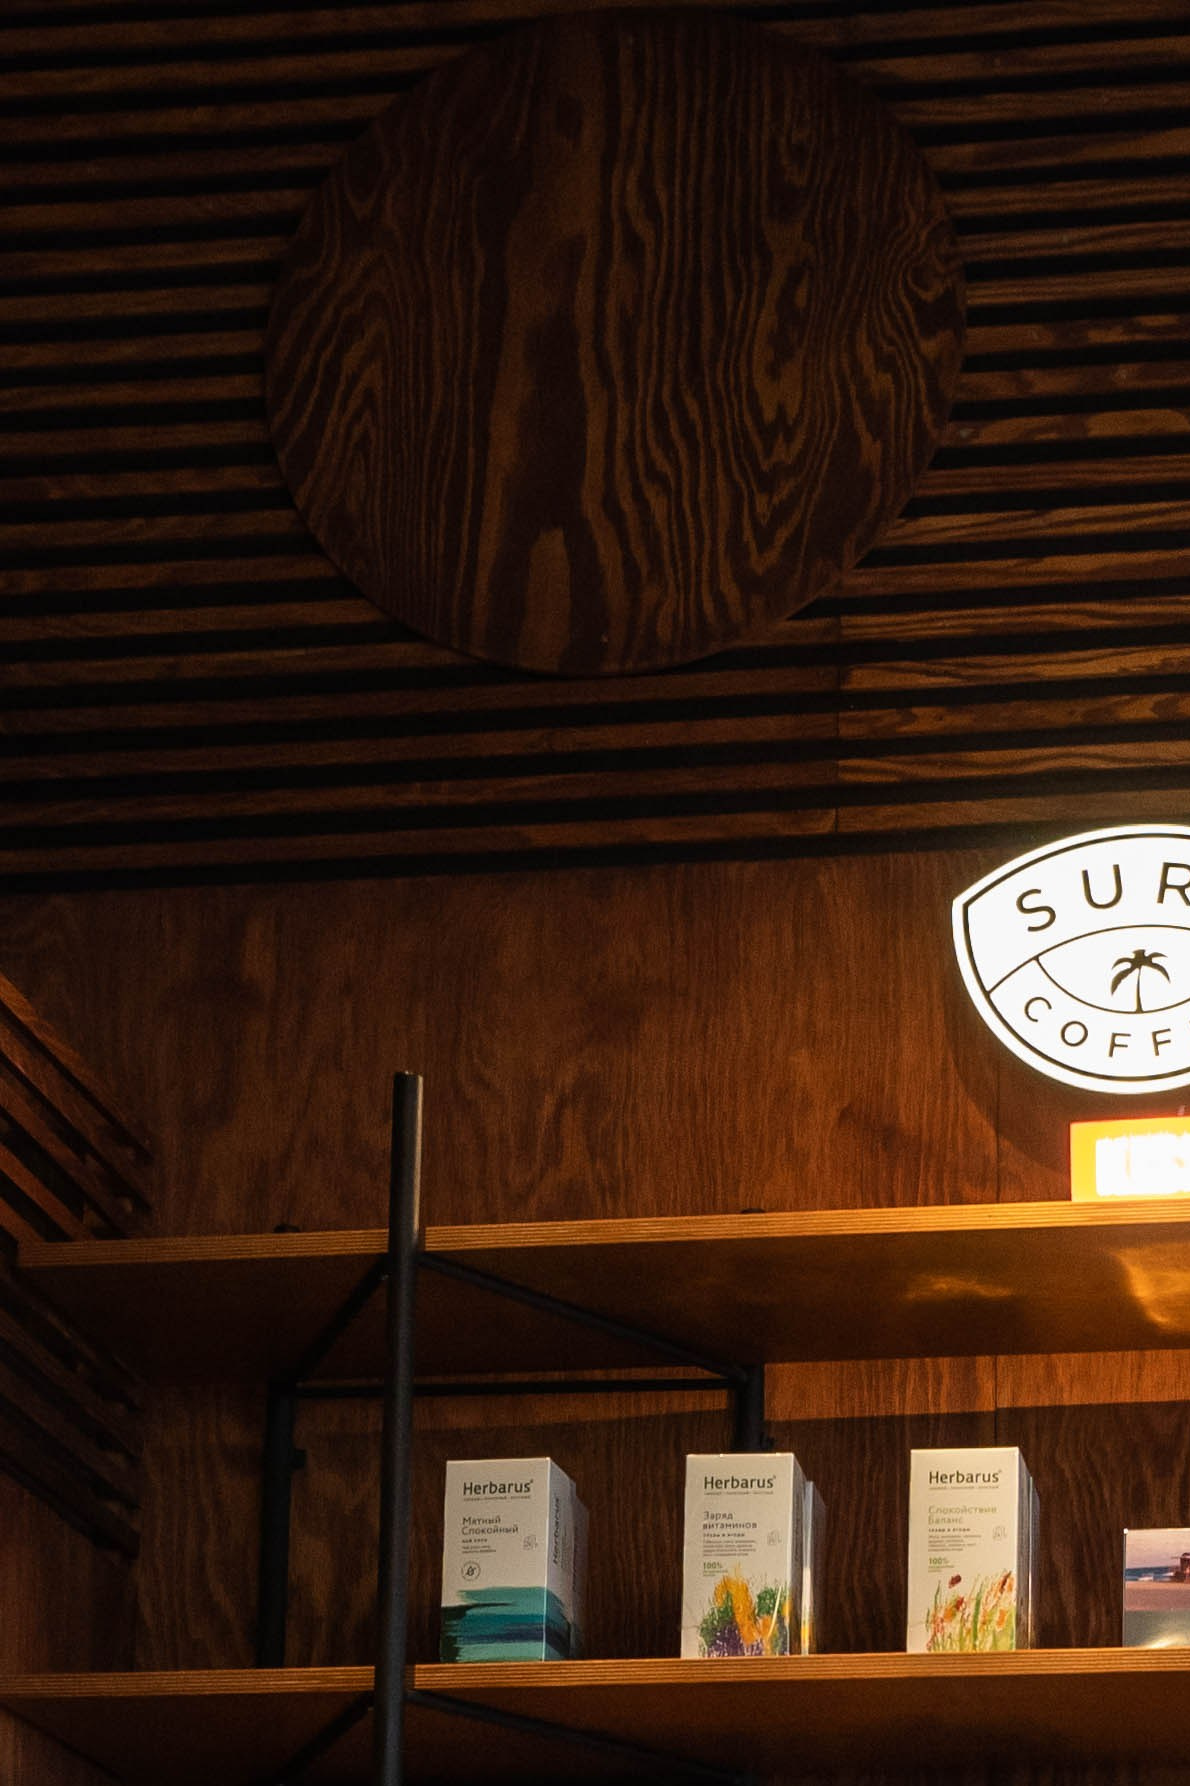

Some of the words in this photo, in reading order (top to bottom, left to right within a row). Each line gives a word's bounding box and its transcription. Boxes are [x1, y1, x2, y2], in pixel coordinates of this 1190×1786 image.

[462, 1515, 501, 1525] Мятный
[703, 1510, 734, 1520] Заряд
[462, 1524, 519, 1535] Спокойный
[703, 1522, 758, 1530] витаминов
